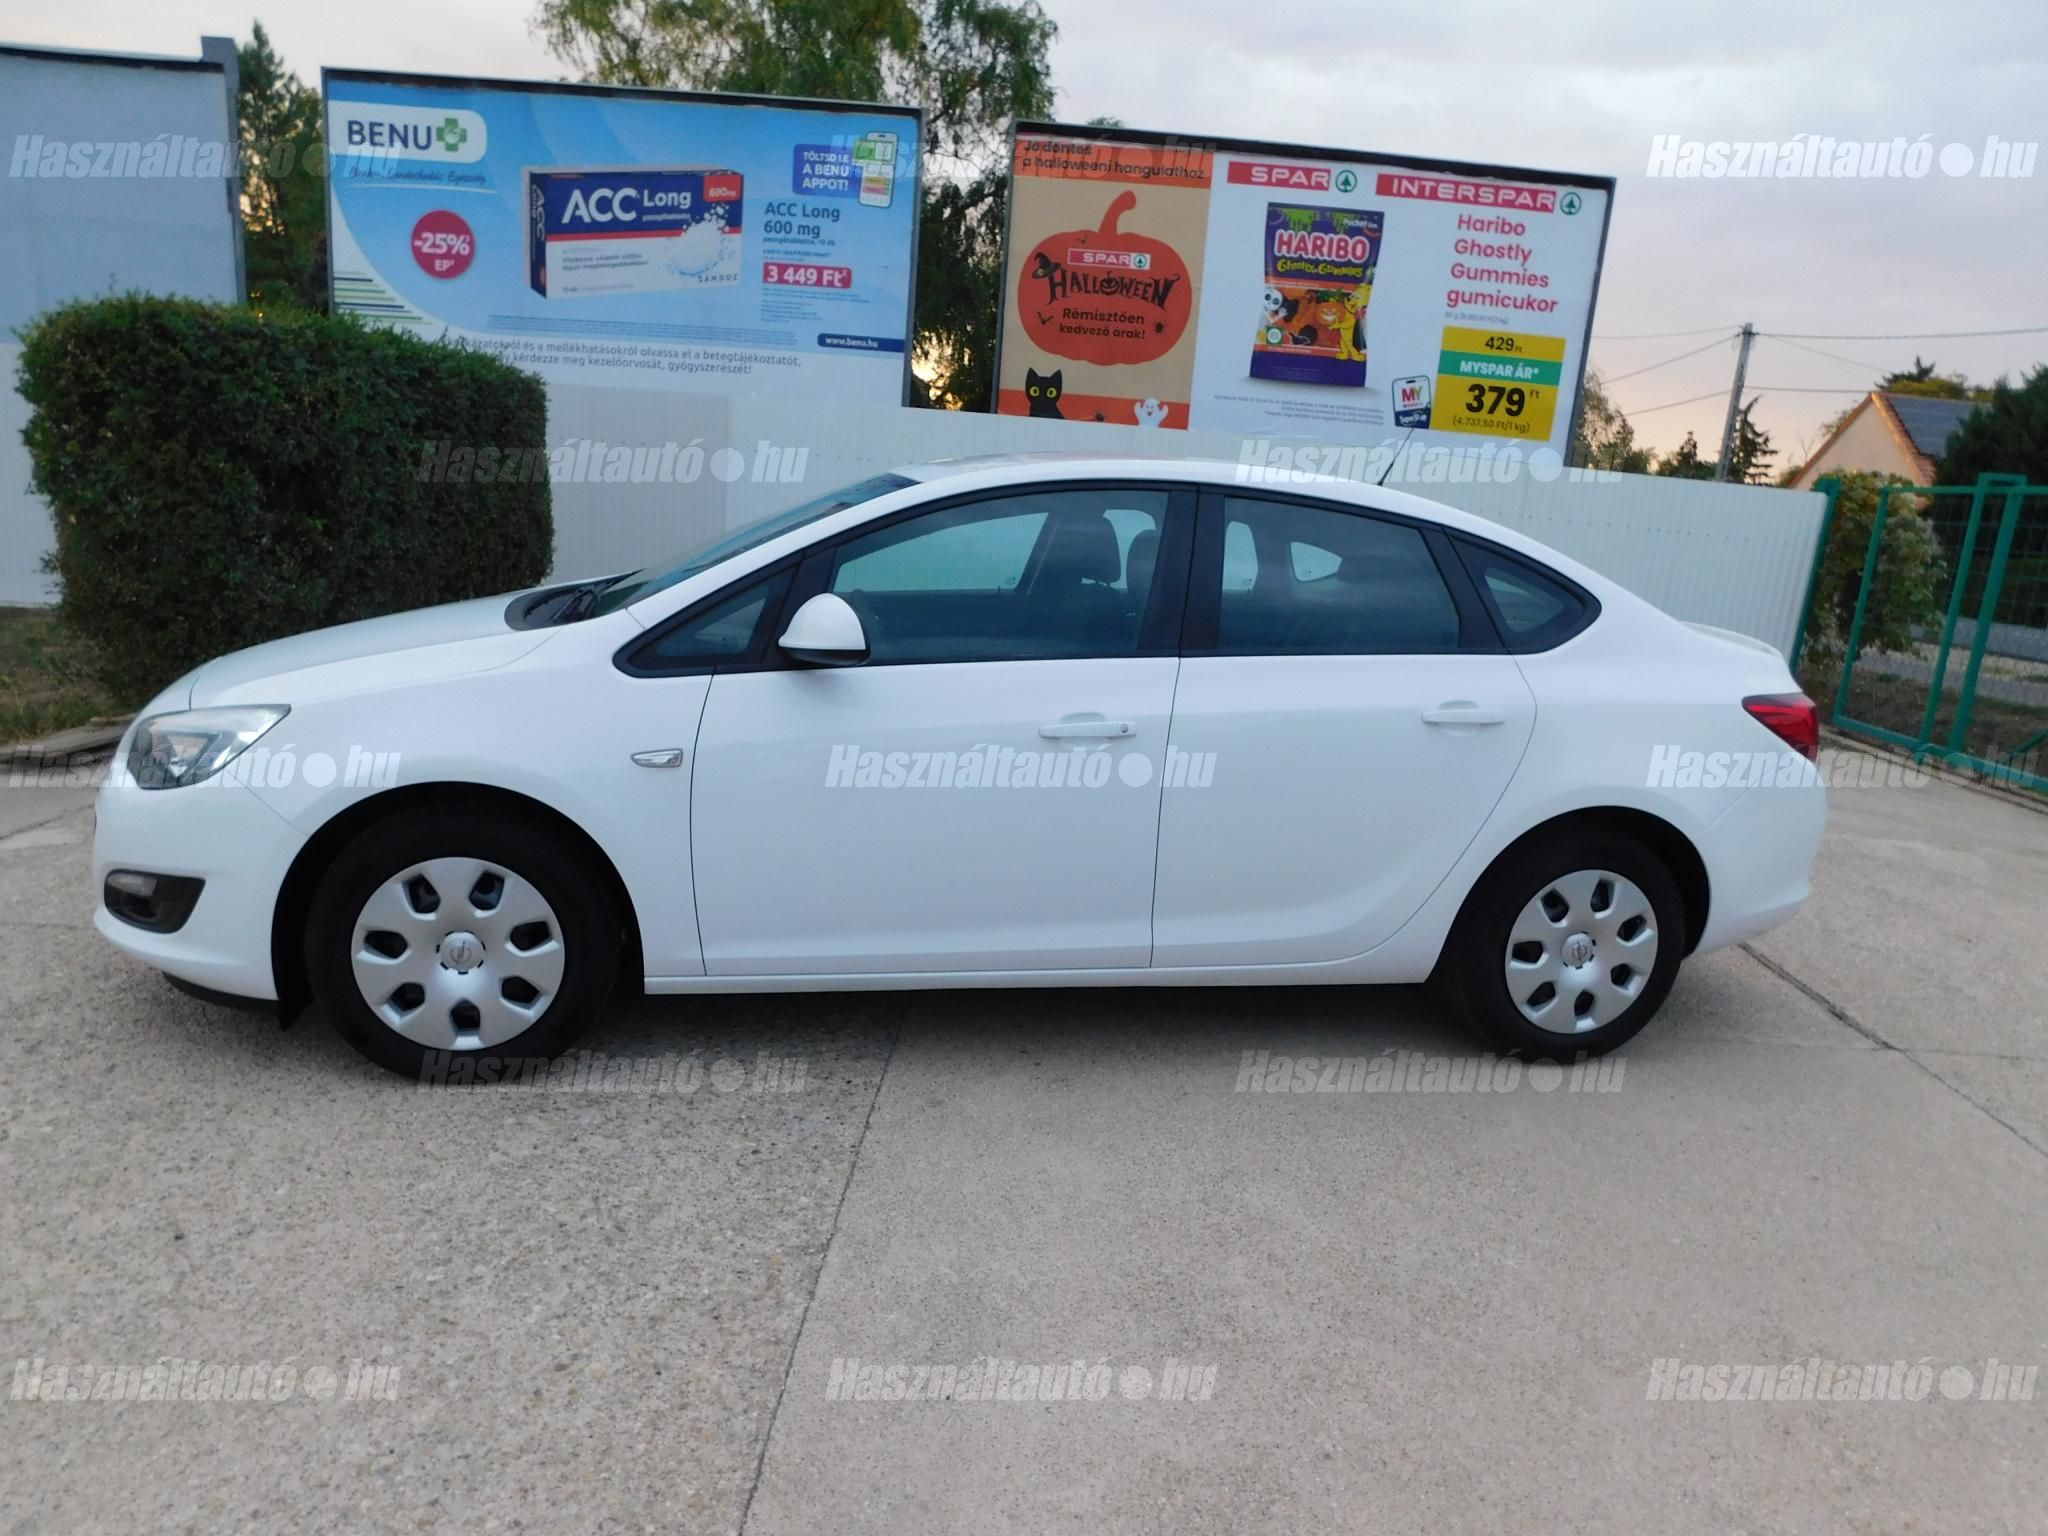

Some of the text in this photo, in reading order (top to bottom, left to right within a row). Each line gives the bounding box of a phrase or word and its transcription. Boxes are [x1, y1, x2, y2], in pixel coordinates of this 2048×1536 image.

[347, 119, 432, 151] BENU
[802, 163, 849, 177] A BENU
[1251, 166, 1330, 188] SPAR
[802, 177, 849, 191] APPOT!
[1391, 177, 1555, 210] INTERSPAR
[561, 187, 692, 224] ACC Long
[764, 201, 841, 223] ACC Long
[764, 221, 821, 239] 600 mg
[1457, 213, 1526, 237] Haribo
[1275, 230, 1369, 262] HARIBO
[1453, 239, 1532, 267] Ghostly
[1083, 252, 1130, 264] SPAR
[767, 266, 778, 282] 3
[783, 267, 818, 285] 449
[1450, 262, 1550, 288] Gummies
[1046, 263, 1180, 311] HALLOWEEN
[1446, 288, 1558, 313] gumicukor
[1062, 307, 1145, 325] Rémisztően
[1059, 322, 1146, 340] kedvező árak!
[538, 343, 546, 351] a
[640, 348, 679, 359] olvassa
[681, 349, 691, 360] el
[694, 351, 700, 360] a
[825, 336, 879, 348] www.benu.hu
[1485, 336, 1514, 352] 429
[513, 351, 560, 364] kérdezze
[562, 355, 585, 367] meg
[1459, 360, 1514, 377] MYSPAR
[1402, 386, 1423, 402] MY
[1465, 383, 1540, 417] 379 Ft
